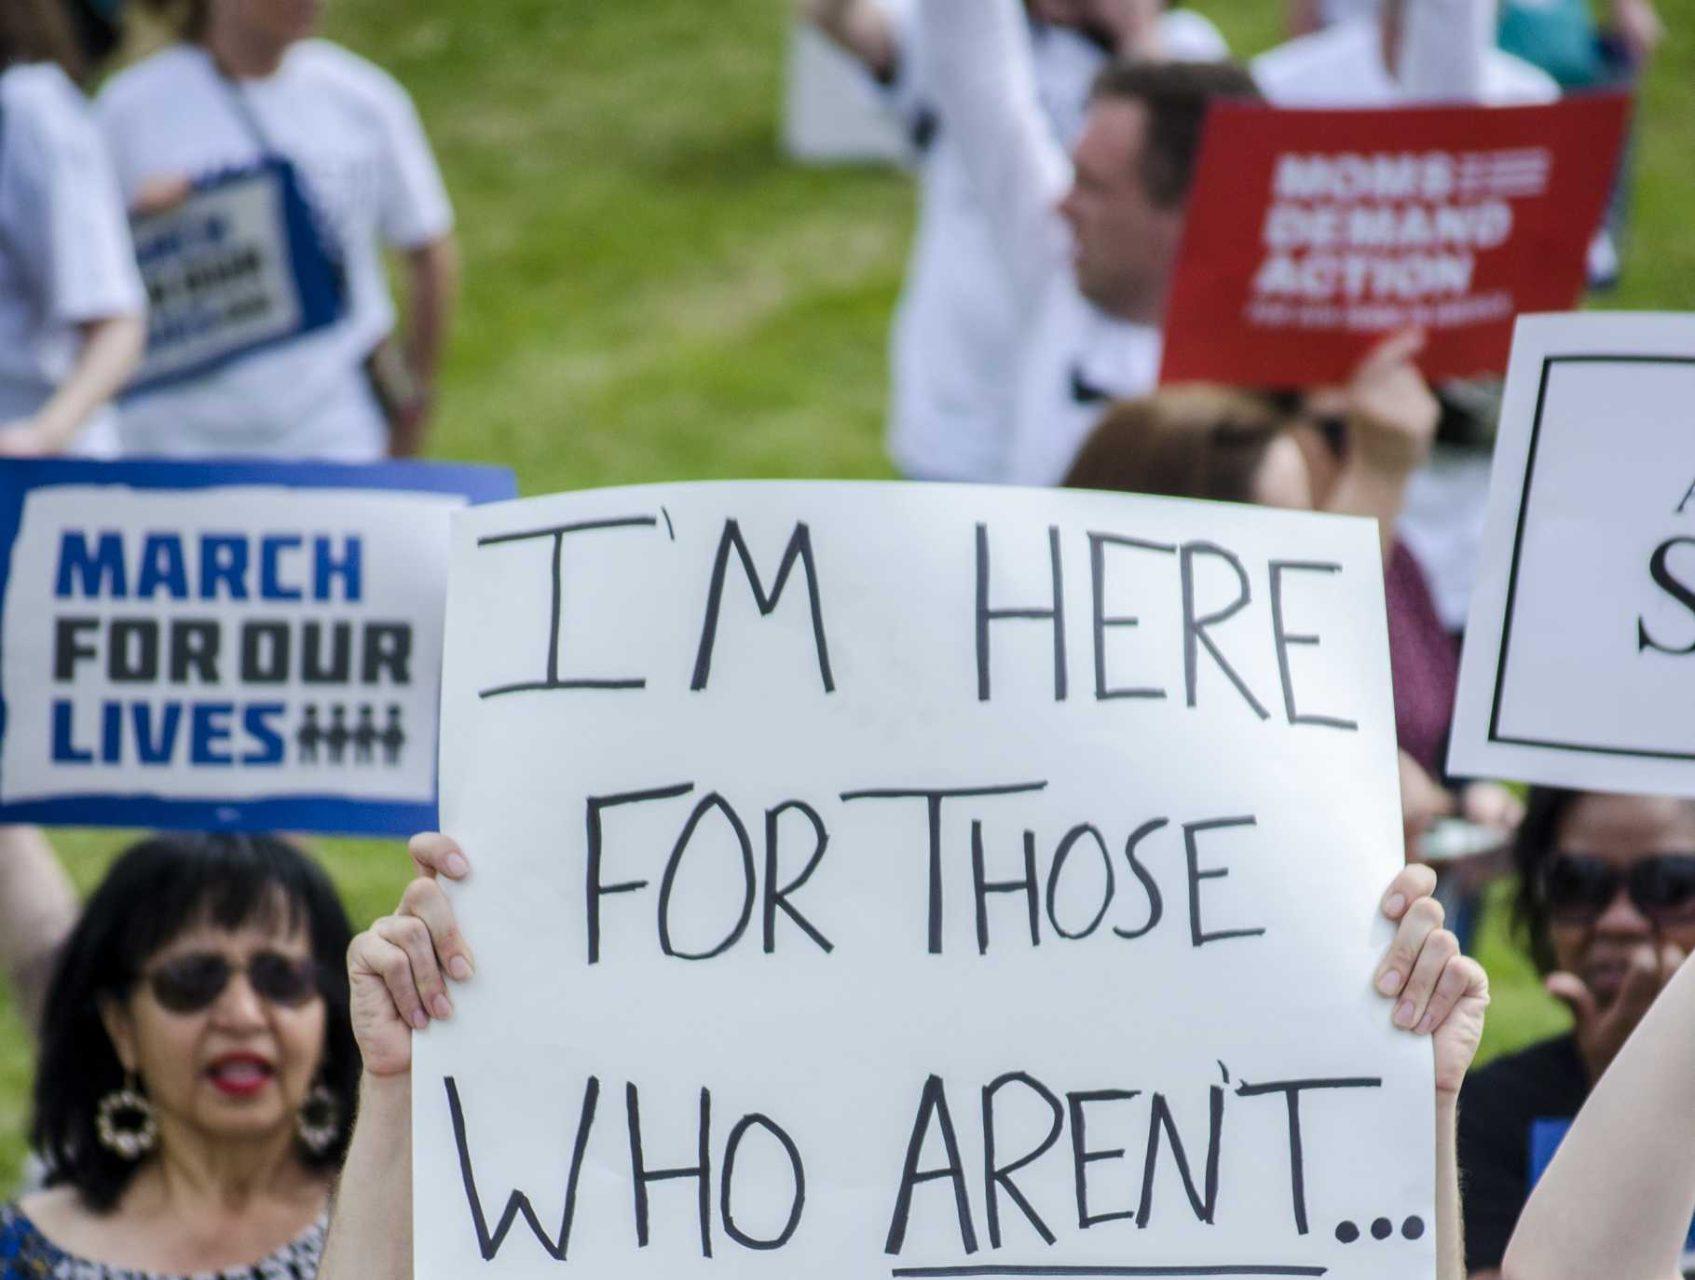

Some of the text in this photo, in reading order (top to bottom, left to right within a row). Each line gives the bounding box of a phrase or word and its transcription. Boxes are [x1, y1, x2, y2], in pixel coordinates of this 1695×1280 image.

[1263, 201, 1514, 250] DEMAND
[1254, 252, 1475, 297] ACTION
[54, 530, 362, 603] MARCH
[53, 616, 412, 685] FOR OUR
[477, 506, 1357, 730] I'M HERE
[51, 698, 286, 767] LIVES
[586, 780, 1266, 965] FOR THOSE
[443, 1075, 805, 1262] WHO
